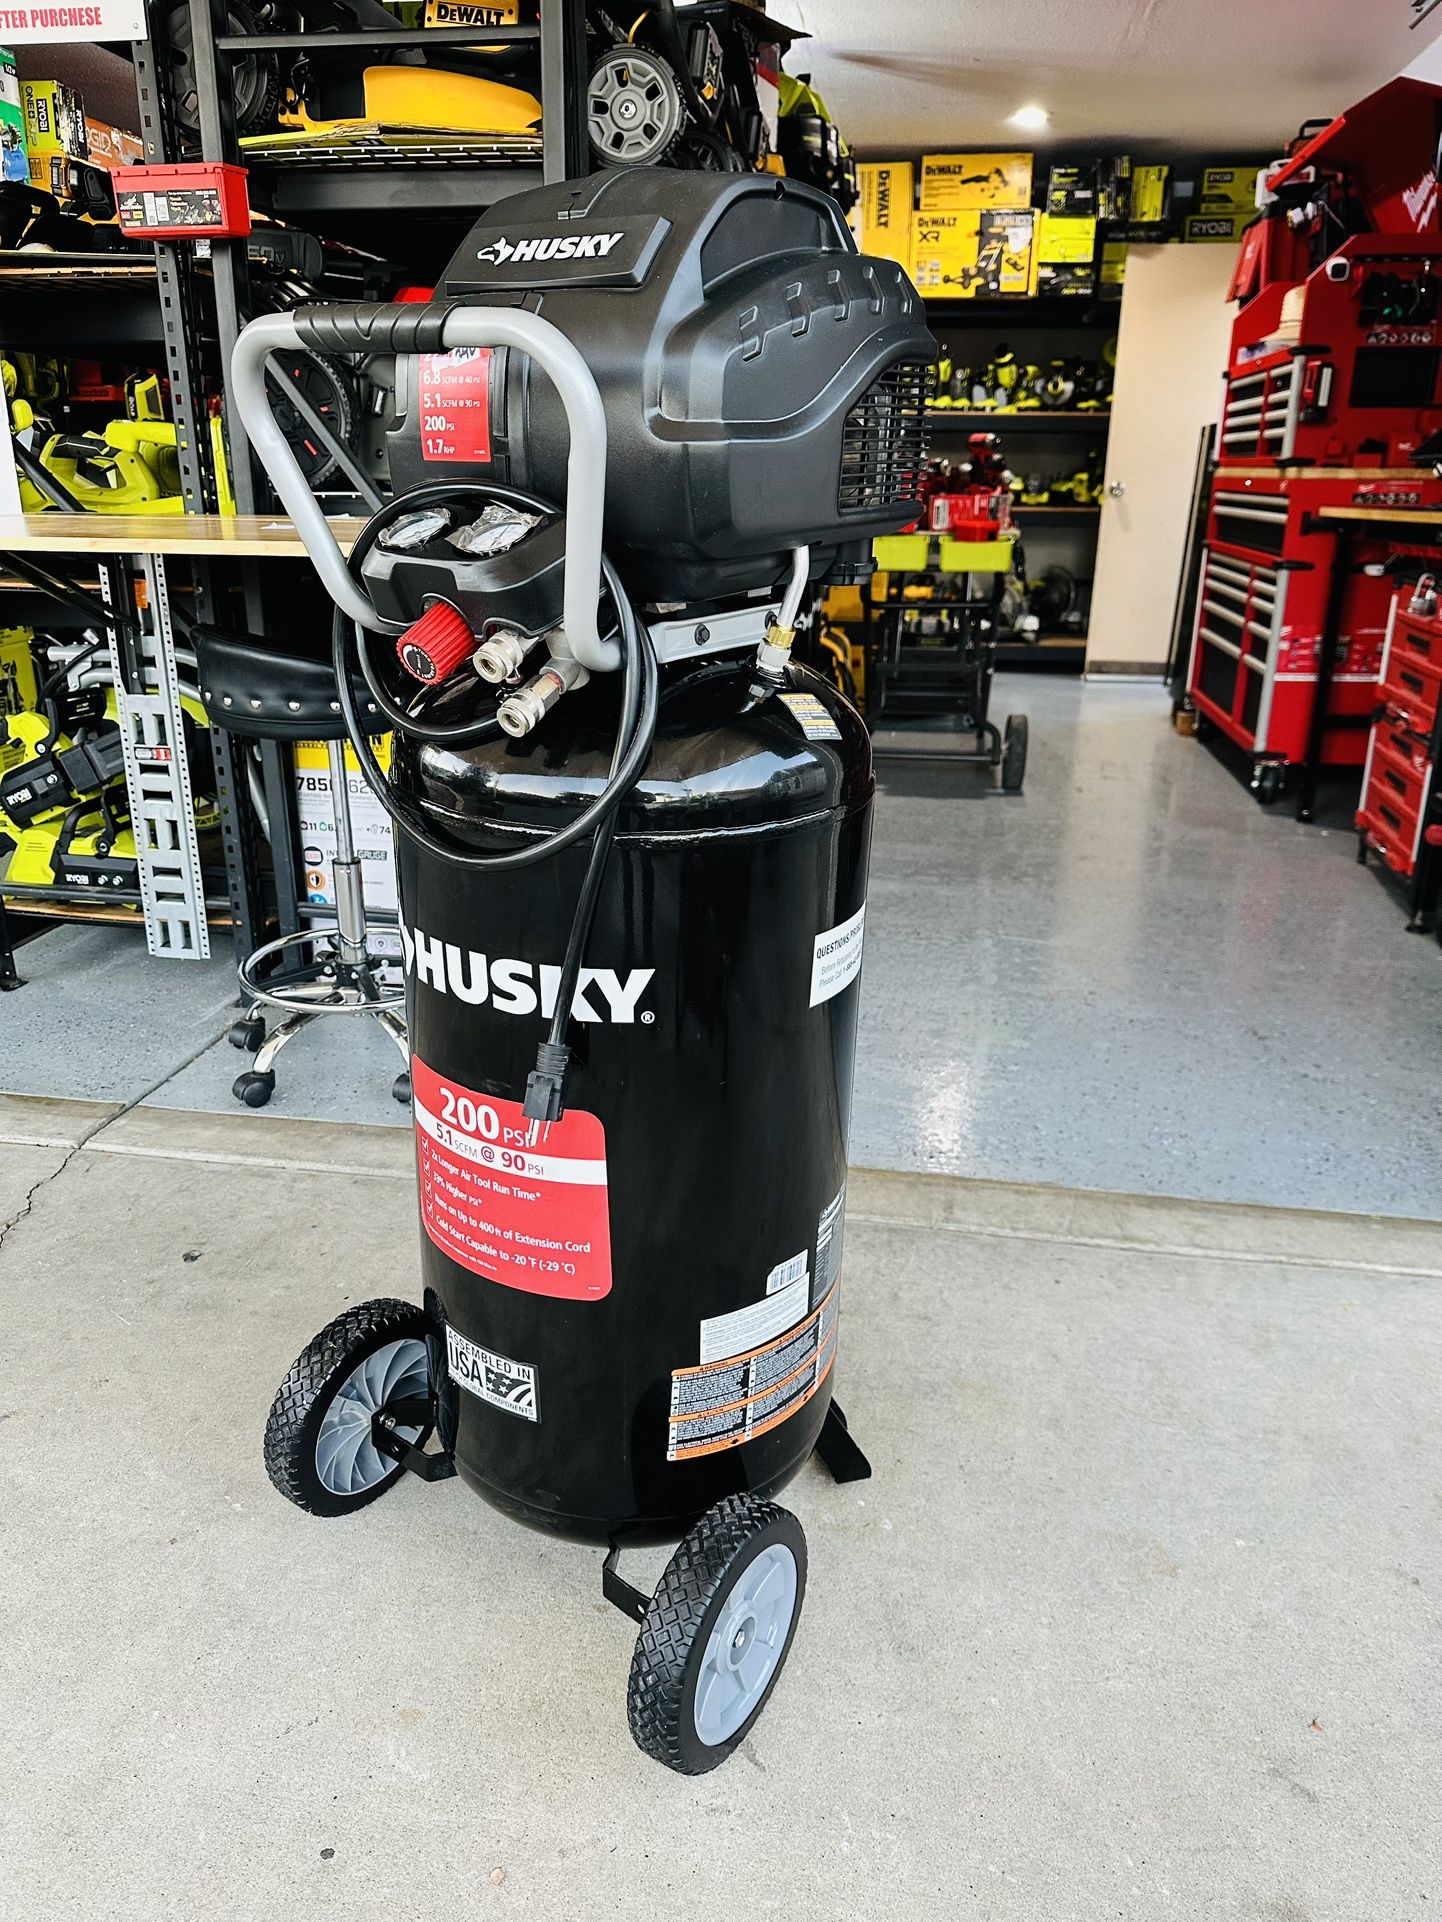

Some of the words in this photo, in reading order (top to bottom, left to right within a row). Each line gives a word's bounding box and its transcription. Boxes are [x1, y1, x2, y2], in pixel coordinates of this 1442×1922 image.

[0, 10, 28, 28] FTER
[31, 7, 102, 27] PURCHESE
[37, 100, 48, 131] RYOBI
[76, 109, 85, 143] RYOBI
[877, 170, 891, 228] DEWALT
[1192, 221, 1231, 234] RYOBI
[510, 232, 624, 262] HUSKY
[423, 370, 441, 385] 6.8
[442, 376, 458, 384] SCFM
[464, 376, 473, 384] 40
[423, 393, 441, 408] 5.1
[442, 399, 458, 407] SCFM
[465, 399, 473, 407] 90
[424, 415, 446, 431] 200
[427, 439, 444, 454] 1.7
[295, 777, 332, 791] 785
[414, 927, 656, 1023] HUSKY
[439, 1087, 499, 1140] 200
[503, 1127, 530, 1148] PSI
[436, 1123, 453, 1146] 5.1
[454, 1140, 478, 1158] SCFM
[481, 1146, 495, 1162] @
[501, 1151, 526, 1171] 90
[528, 1163, 544, 1175] PSI
[438, 1155, 459, 1175] Longer
[460, 1169, 471, 1182] Air
[472, 1174, 491, 1188] Tool
[493, 1183, 510, 1195] Run
[446, 1181, 468, 1203] Higher
[434, 1193, 448, 1212] Runs
[448, 1206, 457, 1216] on
[457, 1209, 468, 1224] Up
[469, 1216, 478, 1228] to
[479, 1220, 495, 1236] 400
[495, 1228, 502, 1237] ft
[503, 1229, 514, 1240] of
[515, 1232, 563, 1251] Extension
[565, 1241, 591, 1253] Cord
[435, 1215, 449, 1232] Cold
[449, 1225, 465, 1242] Start
[465, 1235, 498, 1258] Capable
[499, 1248, 509, 1261] to
[511, 1254, 526, 1265] -20
[538, 1259, 559, 1272] (-29
[448, 1330, 512, 1374] ASSEMBLED
[517, 1367, 531, 1380] IN
[449, 1341, 483, 1388] USA
[486, 1391, 534, 1416] COMPONENTS
